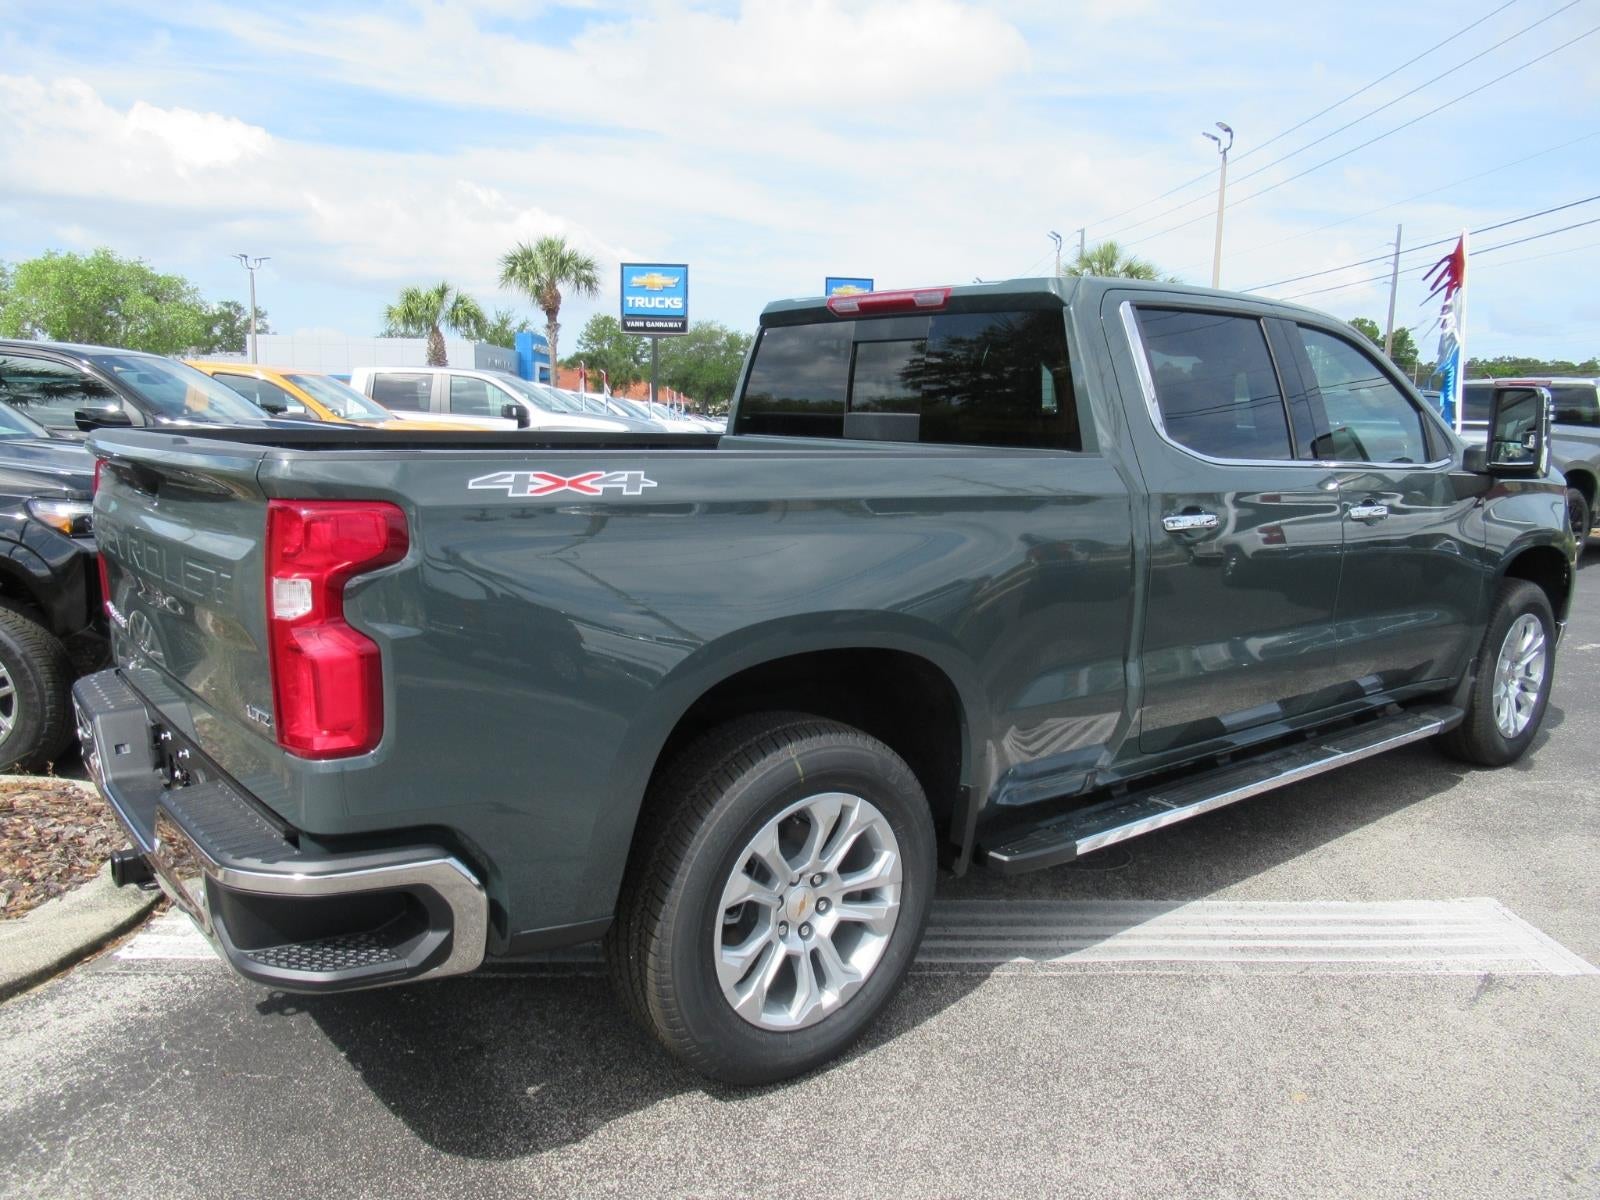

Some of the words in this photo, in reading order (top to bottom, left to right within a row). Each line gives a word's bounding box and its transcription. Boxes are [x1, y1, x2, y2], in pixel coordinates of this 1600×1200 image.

[626, 296, 683, 309] TRUCKS
[626, 320, 645, 328] VANN
[645, 320, 683, 329] GANNAWAY
[467, 470, 659, 497] 4X4
[95, 522, 232, 605] EVROLET
[246, 704, 273, 728] LTZ
